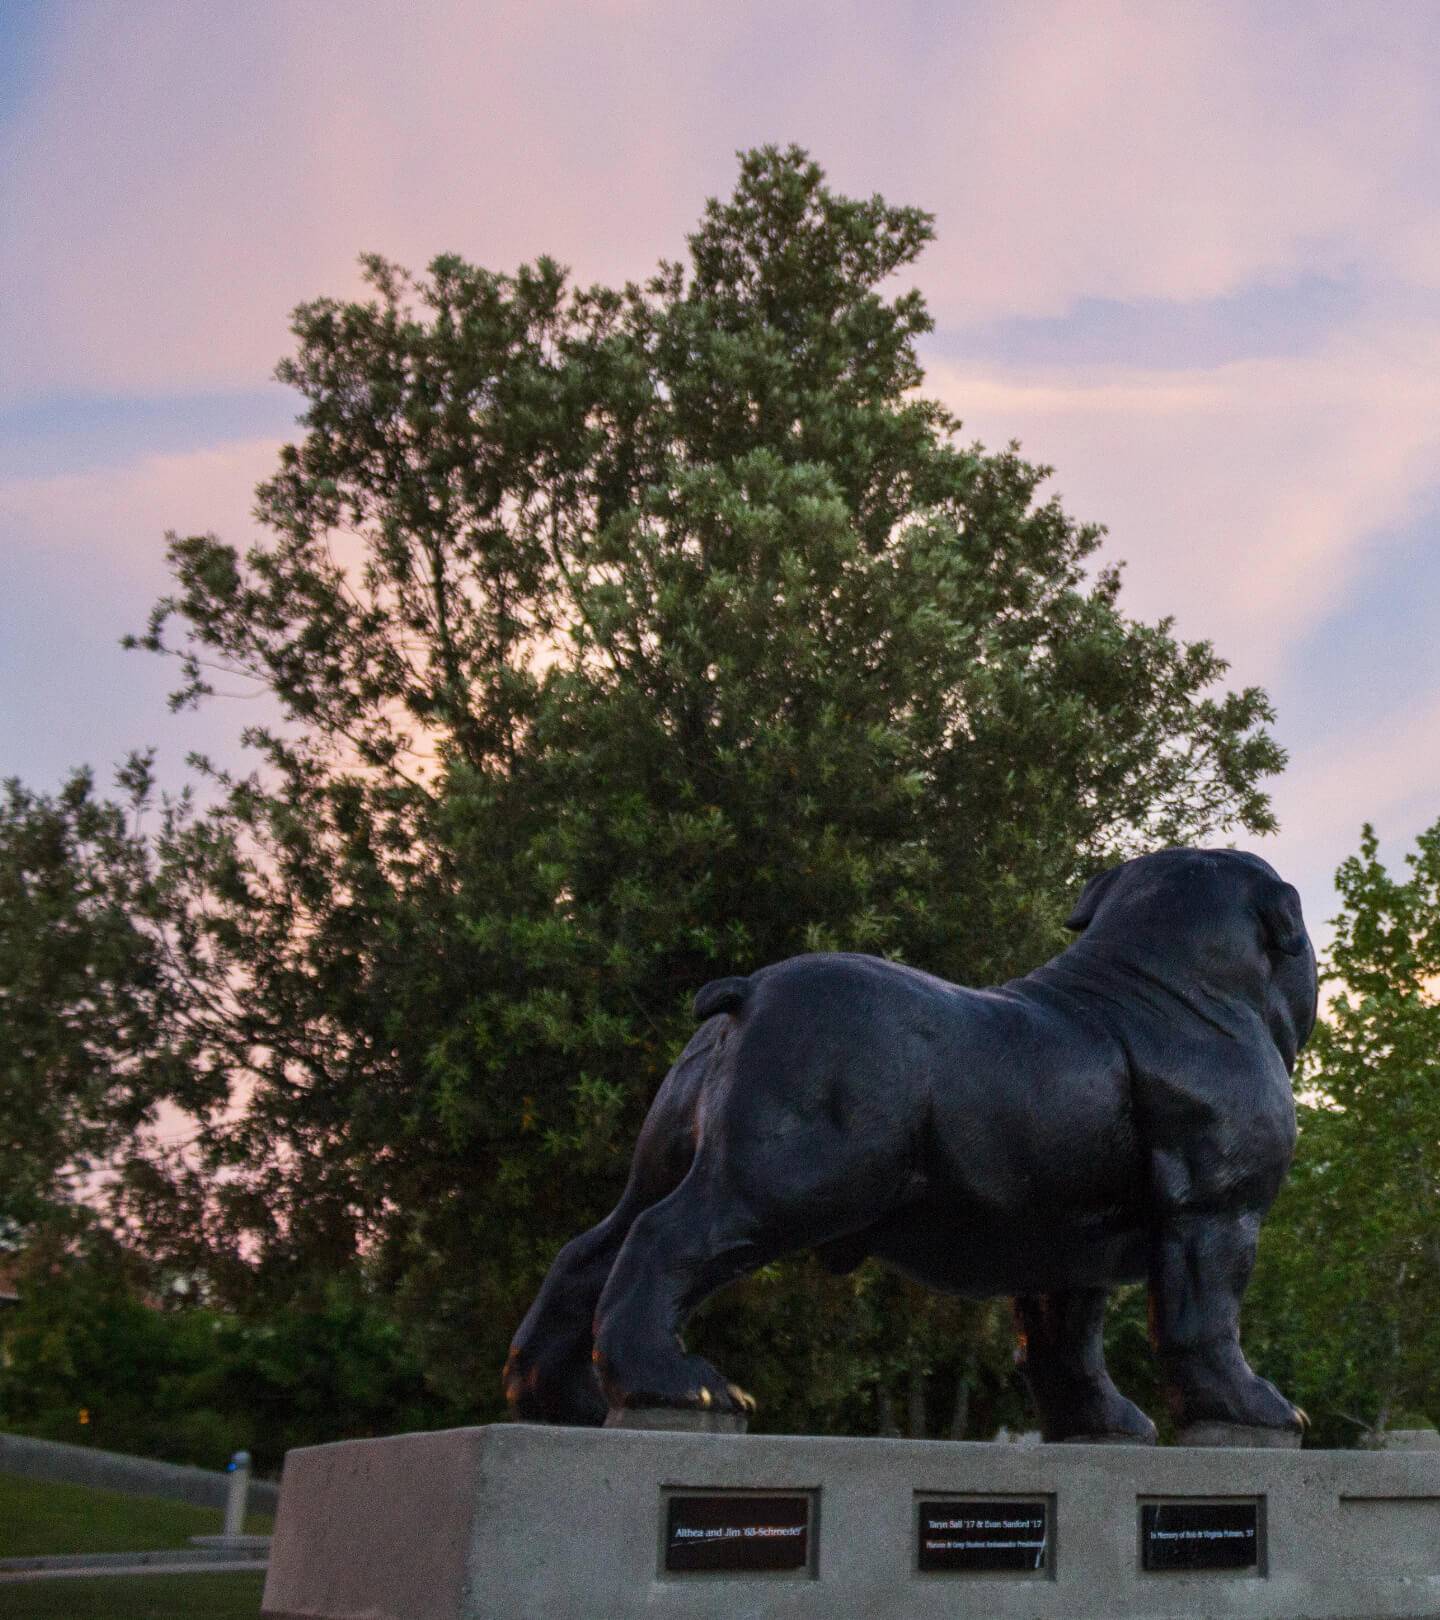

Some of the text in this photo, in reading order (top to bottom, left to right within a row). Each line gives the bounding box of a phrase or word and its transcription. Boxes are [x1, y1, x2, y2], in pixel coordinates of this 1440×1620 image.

[976, 1520, 983, 1529] &
[1003, 1520, 1029, 1529] Sanford
[675, 1527, 703, 1538] Althea
[705, 1527, 722, 1537] and
[724, 1527, 740, 1537] Jim
